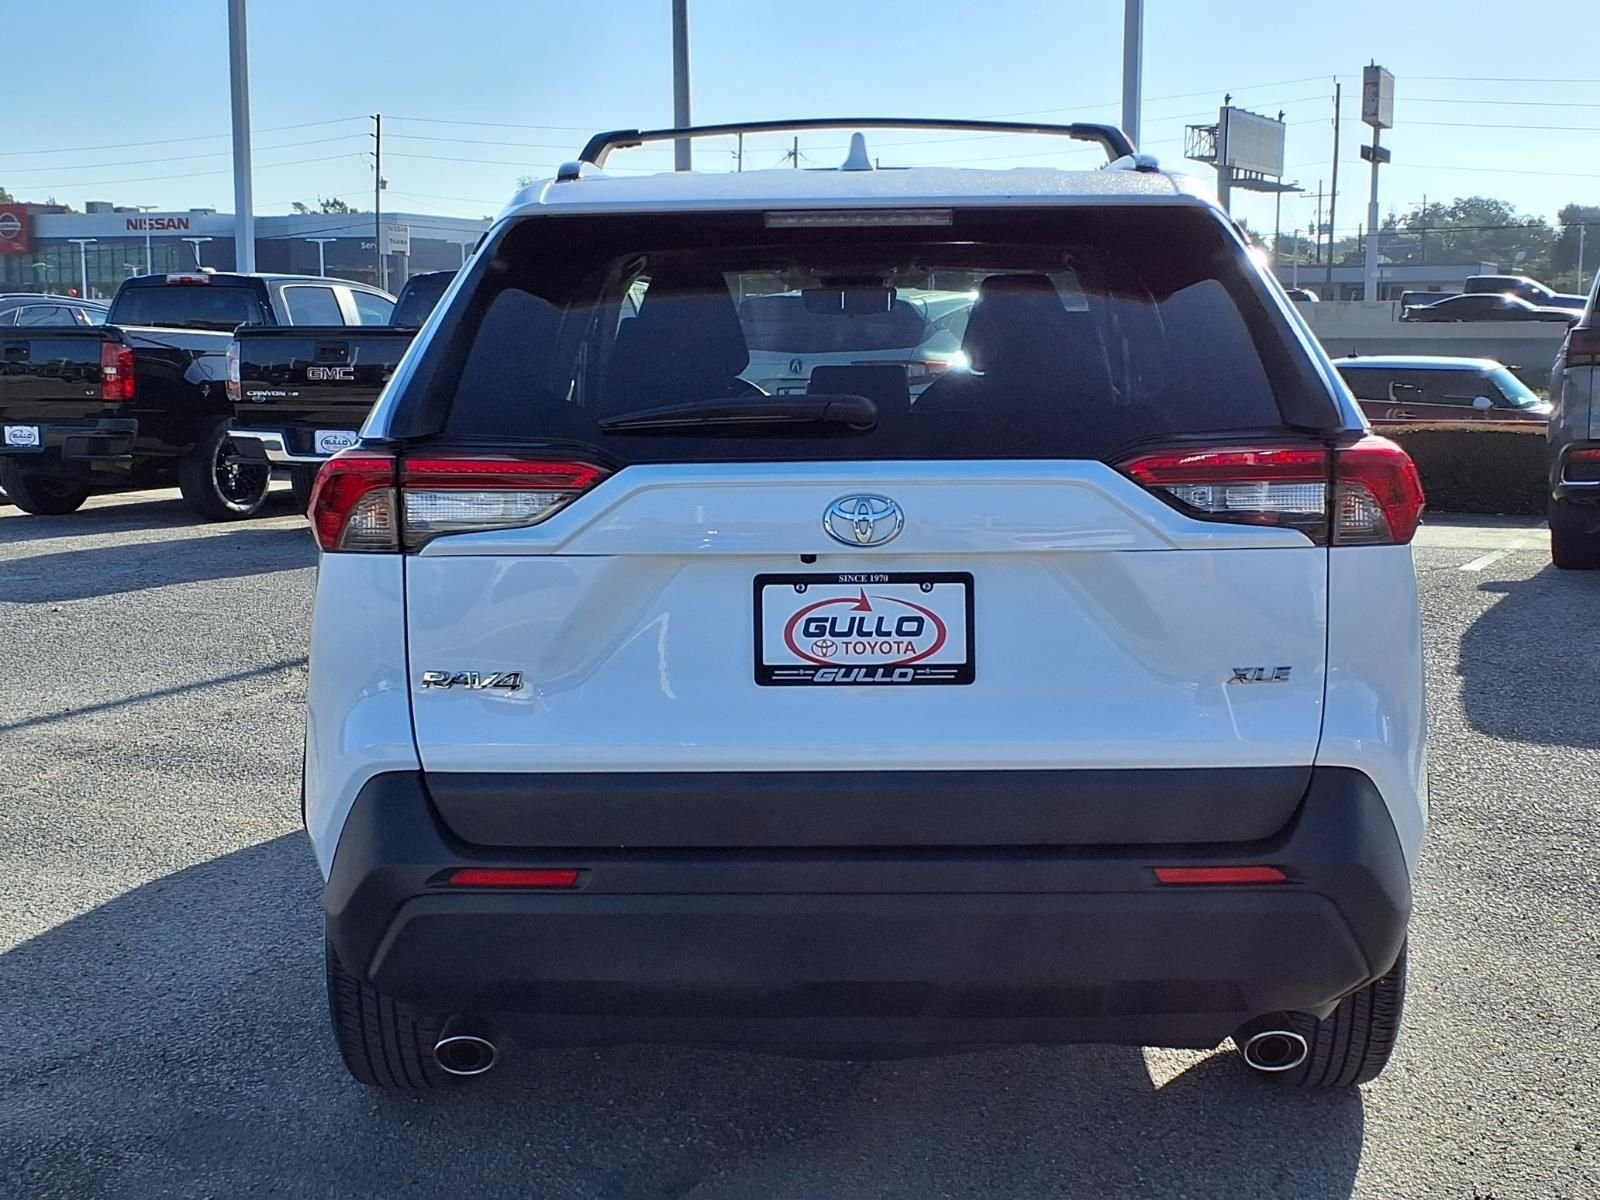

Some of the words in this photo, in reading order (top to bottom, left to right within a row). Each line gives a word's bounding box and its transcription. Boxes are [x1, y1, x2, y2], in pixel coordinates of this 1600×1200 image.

[126, 218, 189, 231] NISSAN
[307, 367, 354, 380] GMC
[324, 439, 349, 447] GULLO
[838, 574, 868, 583] SINCE
[870, 574, 889, 583] 1970
[802, 615, 925, 638] GULLO
[841, 641, 917, 655] TOYOTA
[422, 670, 523, 690] RAV4
[813, 668, 915, 682] GULLO
[1227, 666, 1292, 684] XLE
